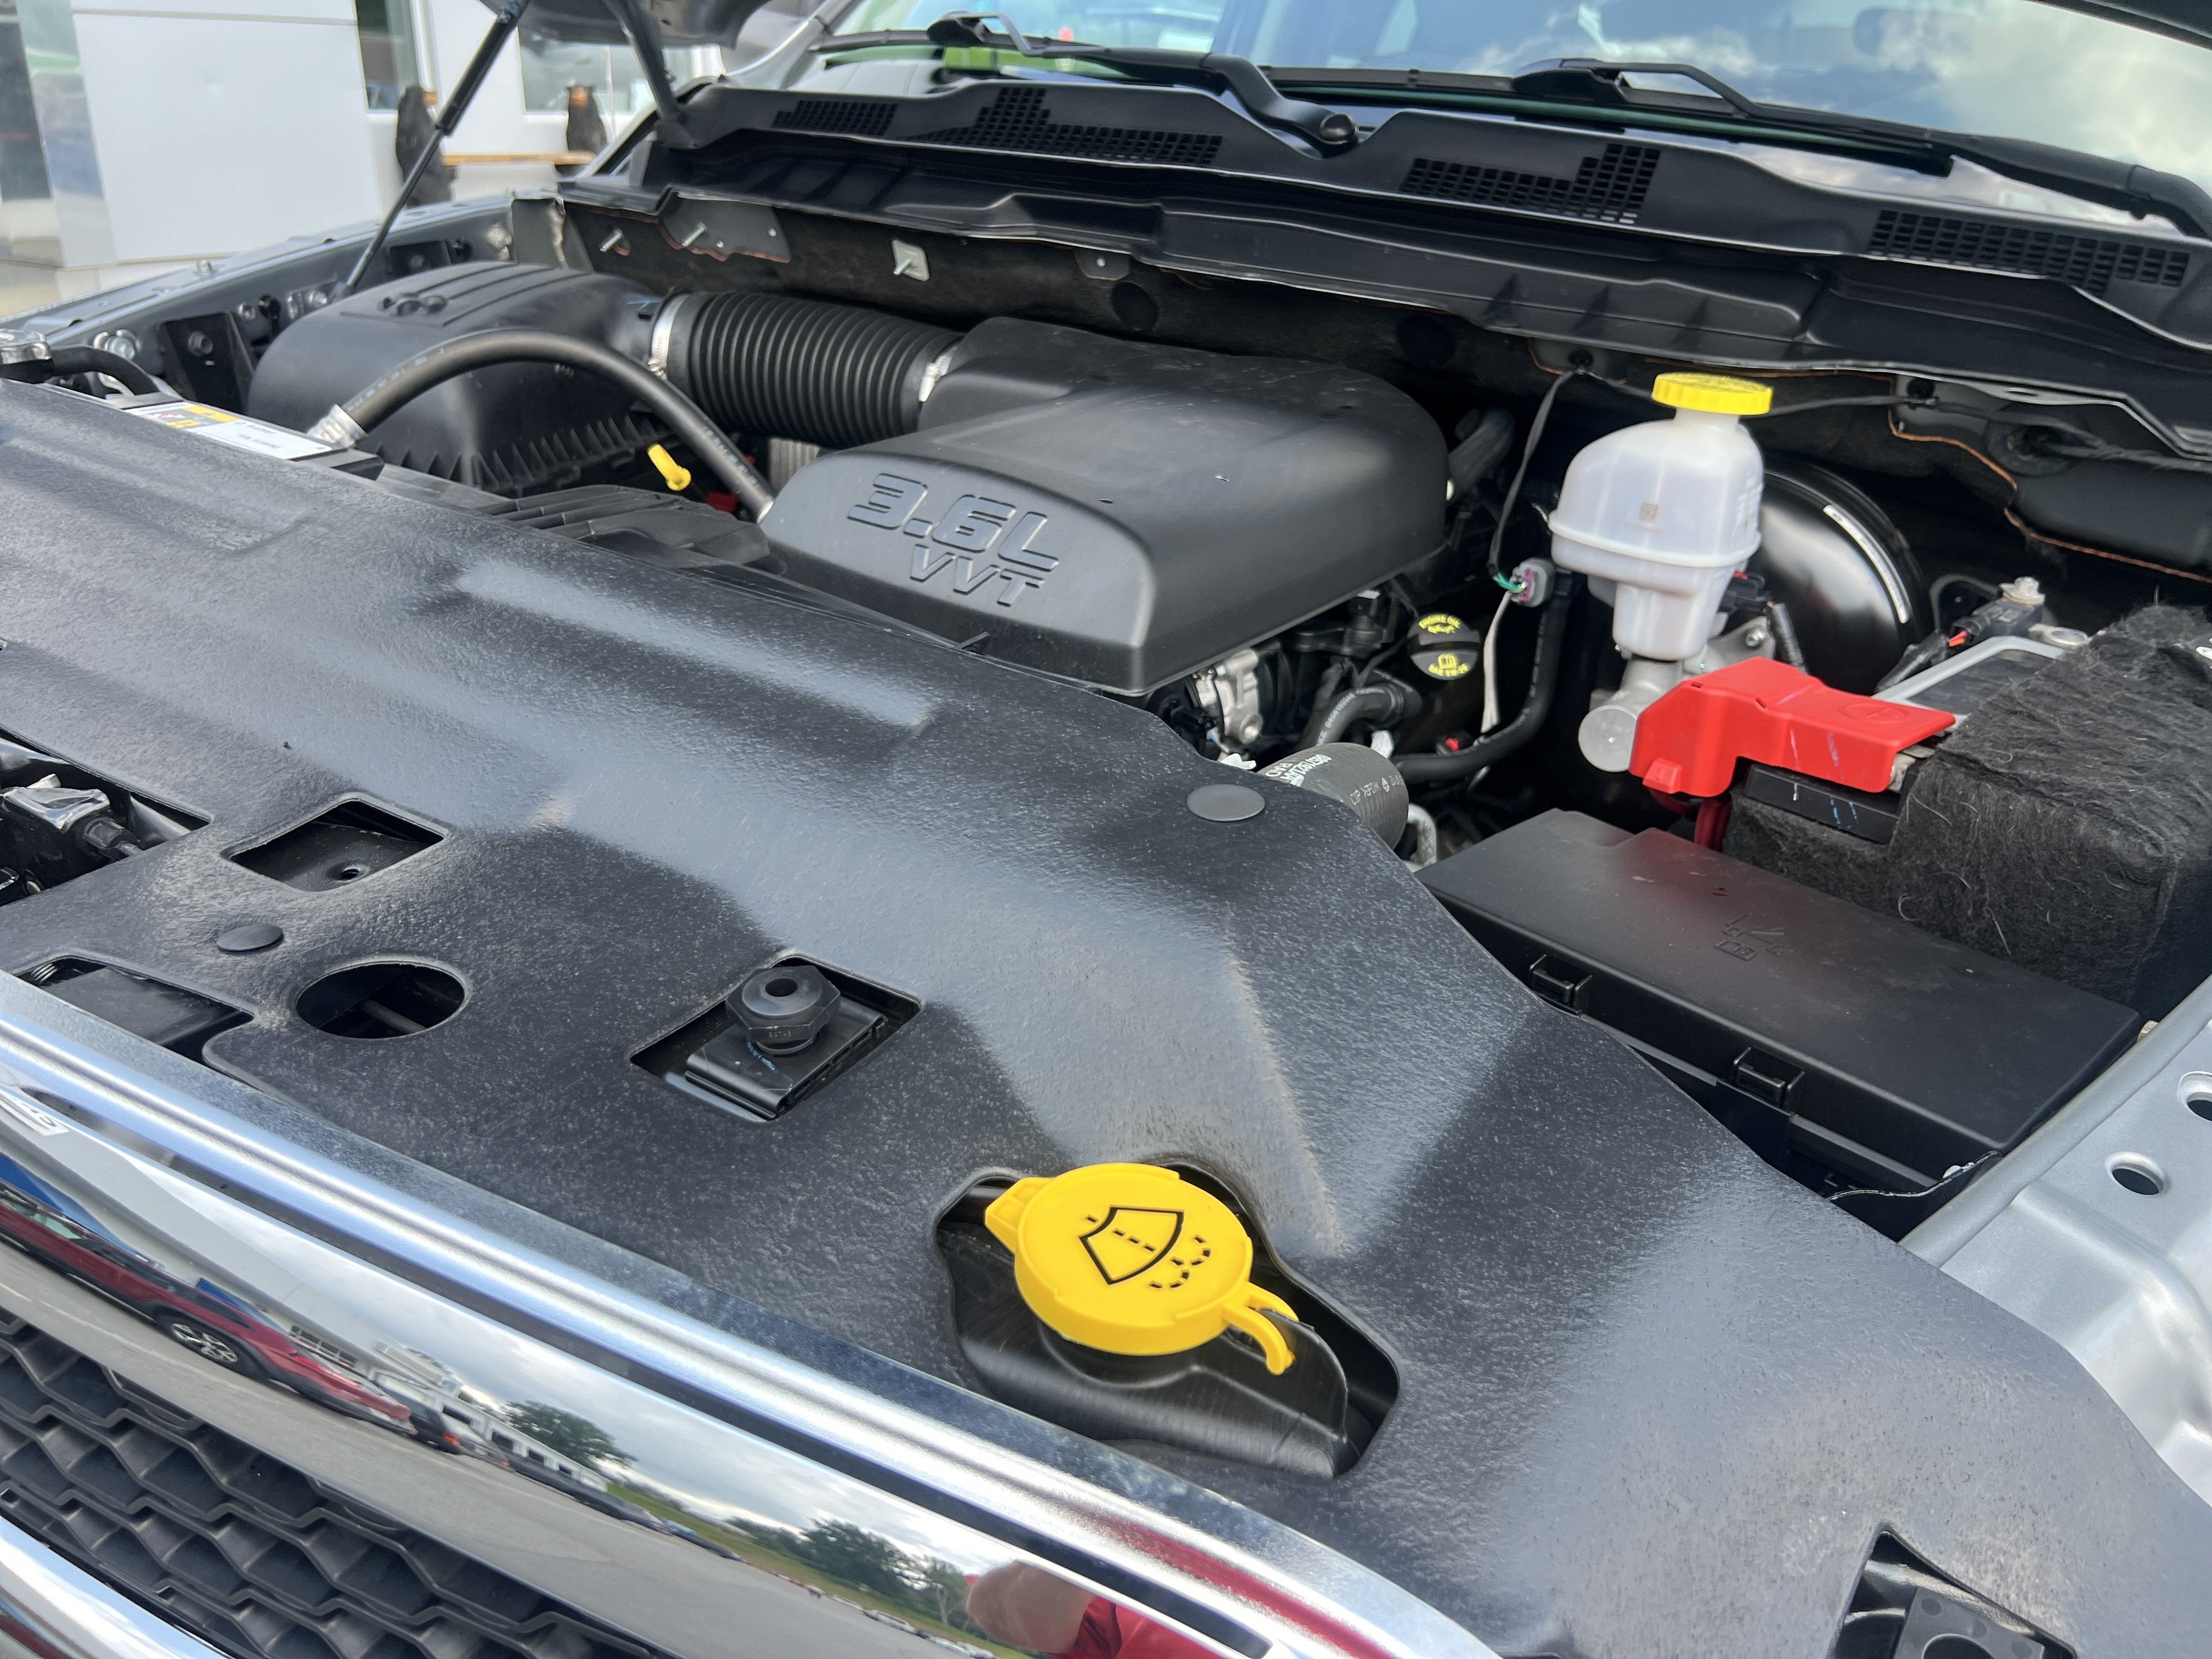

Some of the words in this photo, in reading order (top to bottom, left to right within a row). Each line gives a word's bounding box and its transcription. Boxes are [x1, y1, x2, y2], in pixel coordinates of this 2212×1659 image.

[847, 473, 1059, 572] 3.6L
[910, 544, 1045, 607] VVT
[1419, 614, 1447, 629] ENGINE
